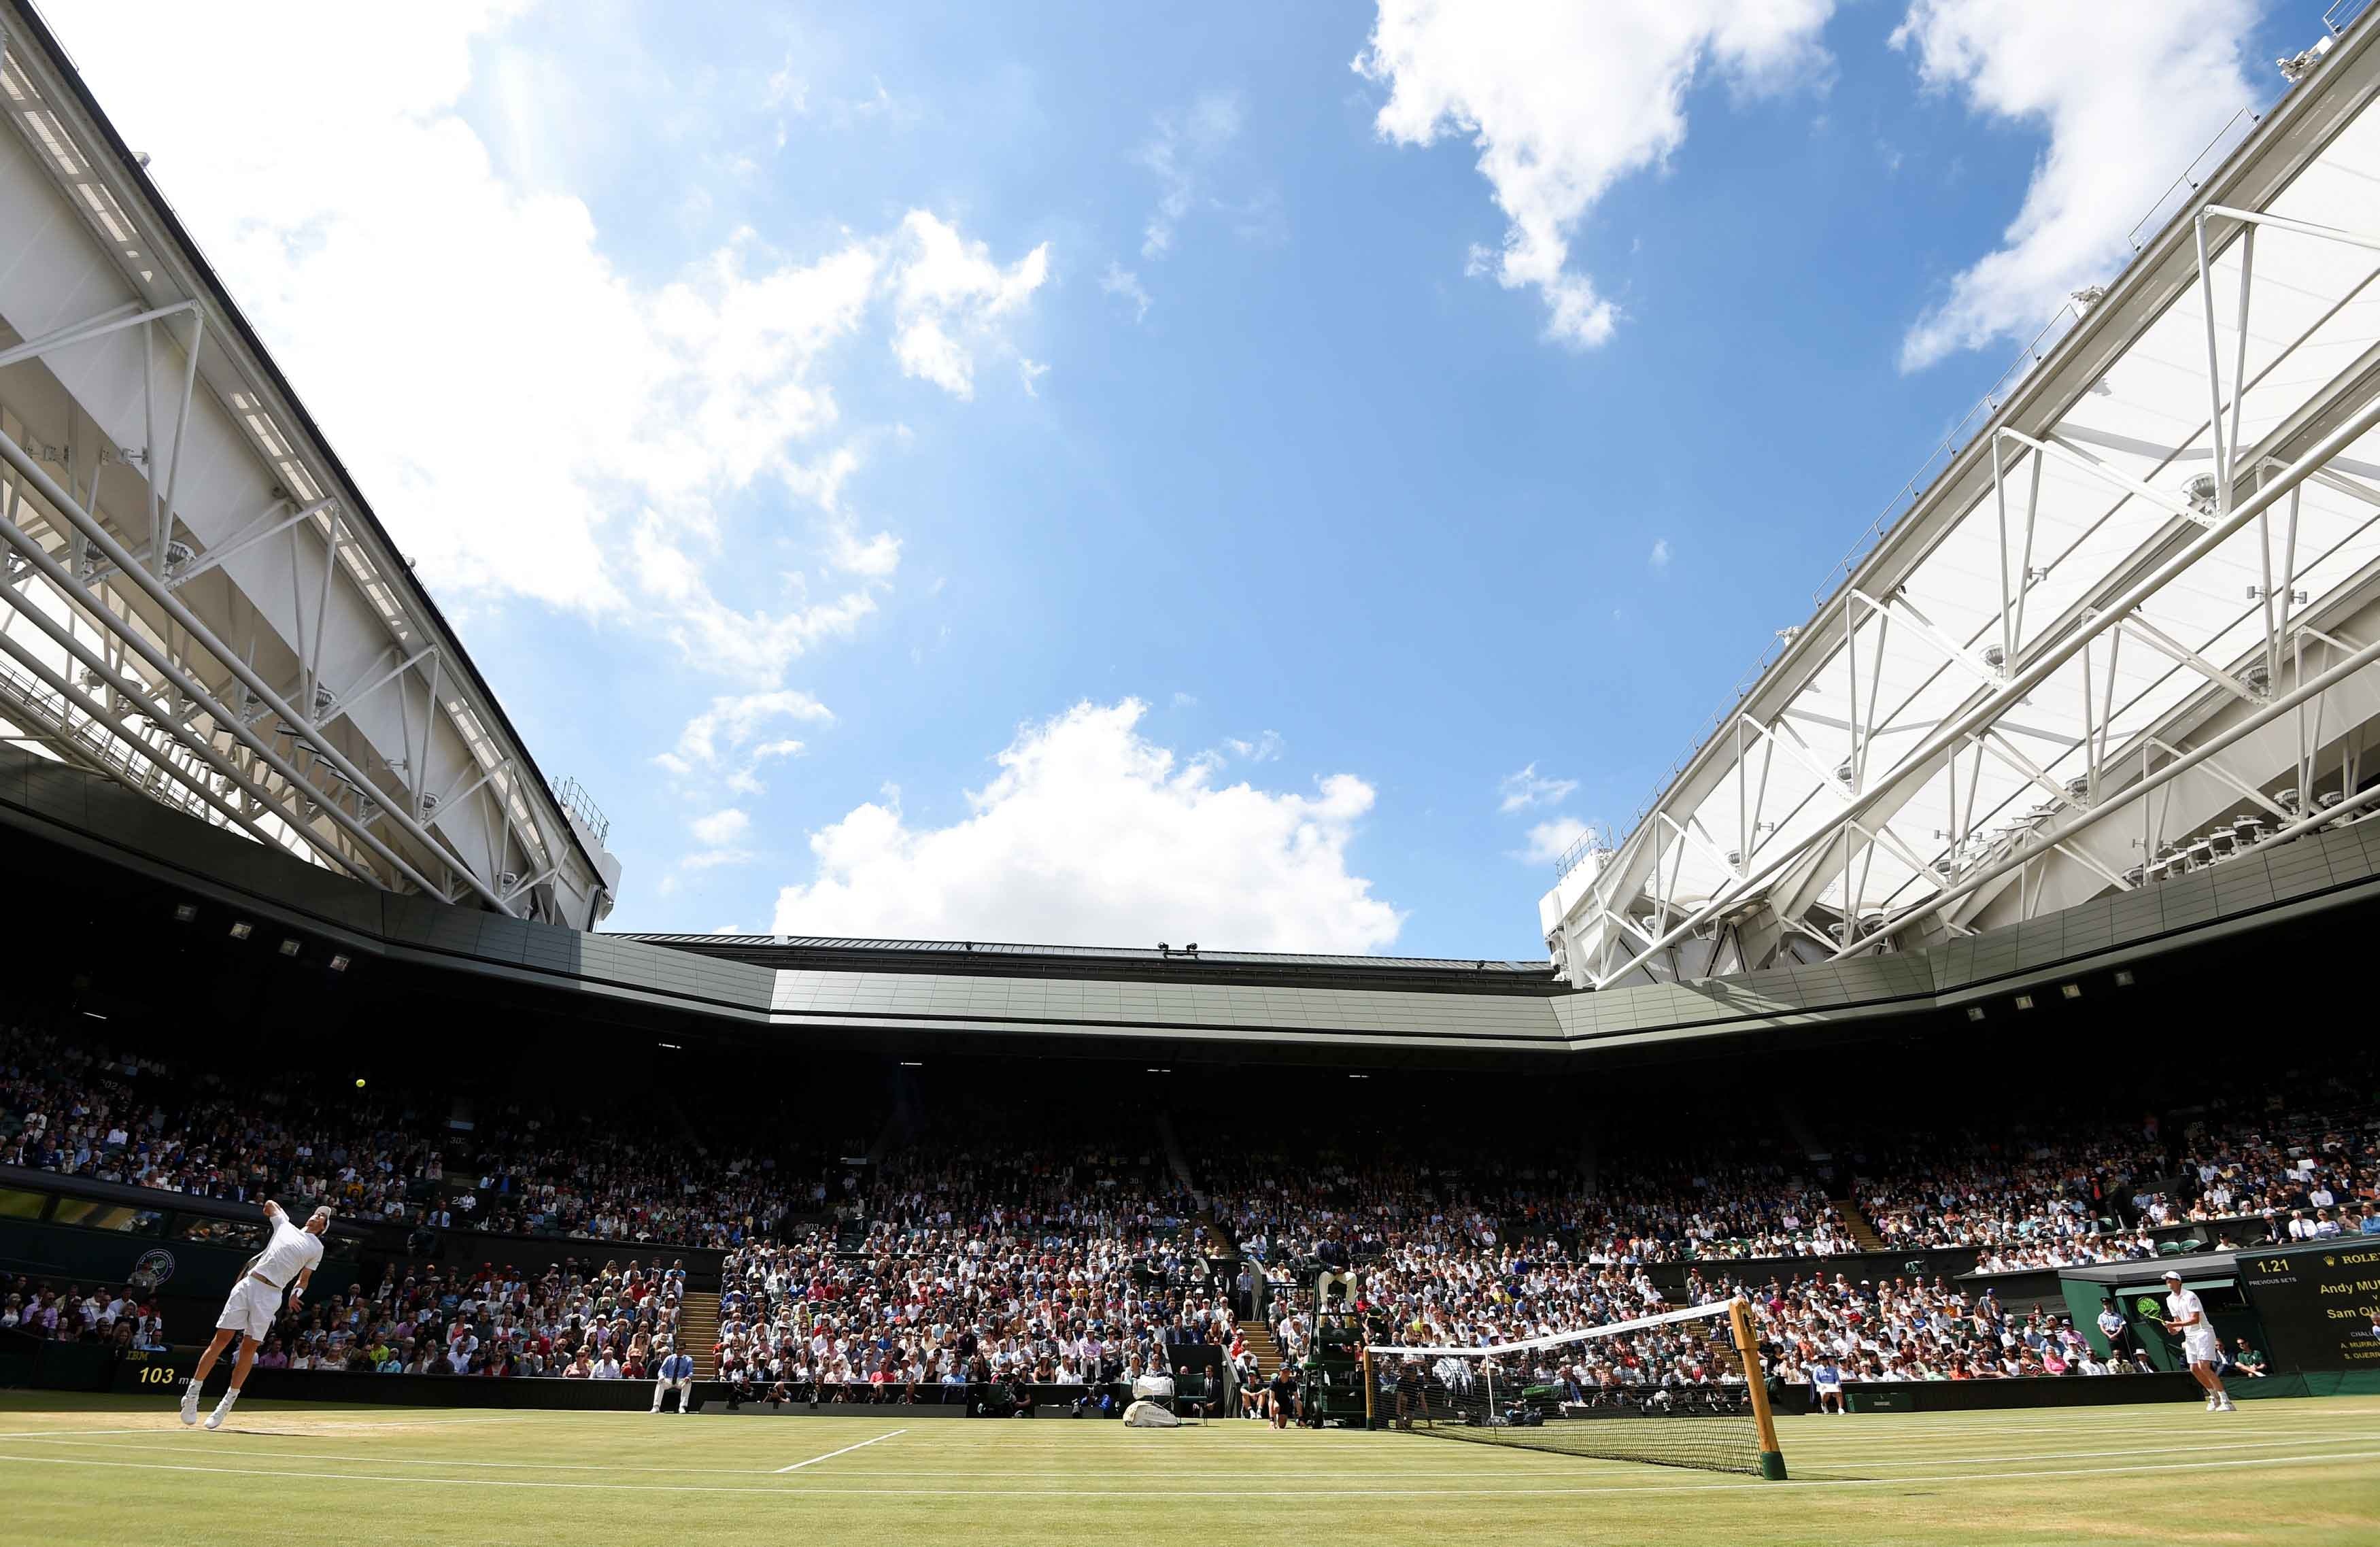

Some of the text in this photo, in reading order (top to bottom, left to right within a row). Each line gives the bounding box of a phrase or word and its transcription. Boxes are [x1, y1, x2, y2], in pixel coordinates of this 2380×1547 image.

[2341, 1253, 2380, 1264] ROLE
[2258, 1259, 2290, 1273] 1.21
[2320, 1283, 2353, 1294] Andy
[2327, 1309, 2356, 1319] Sam
[125, 1350, 149, 1361] IBM
[140, 1367, 175, 1384] 103
